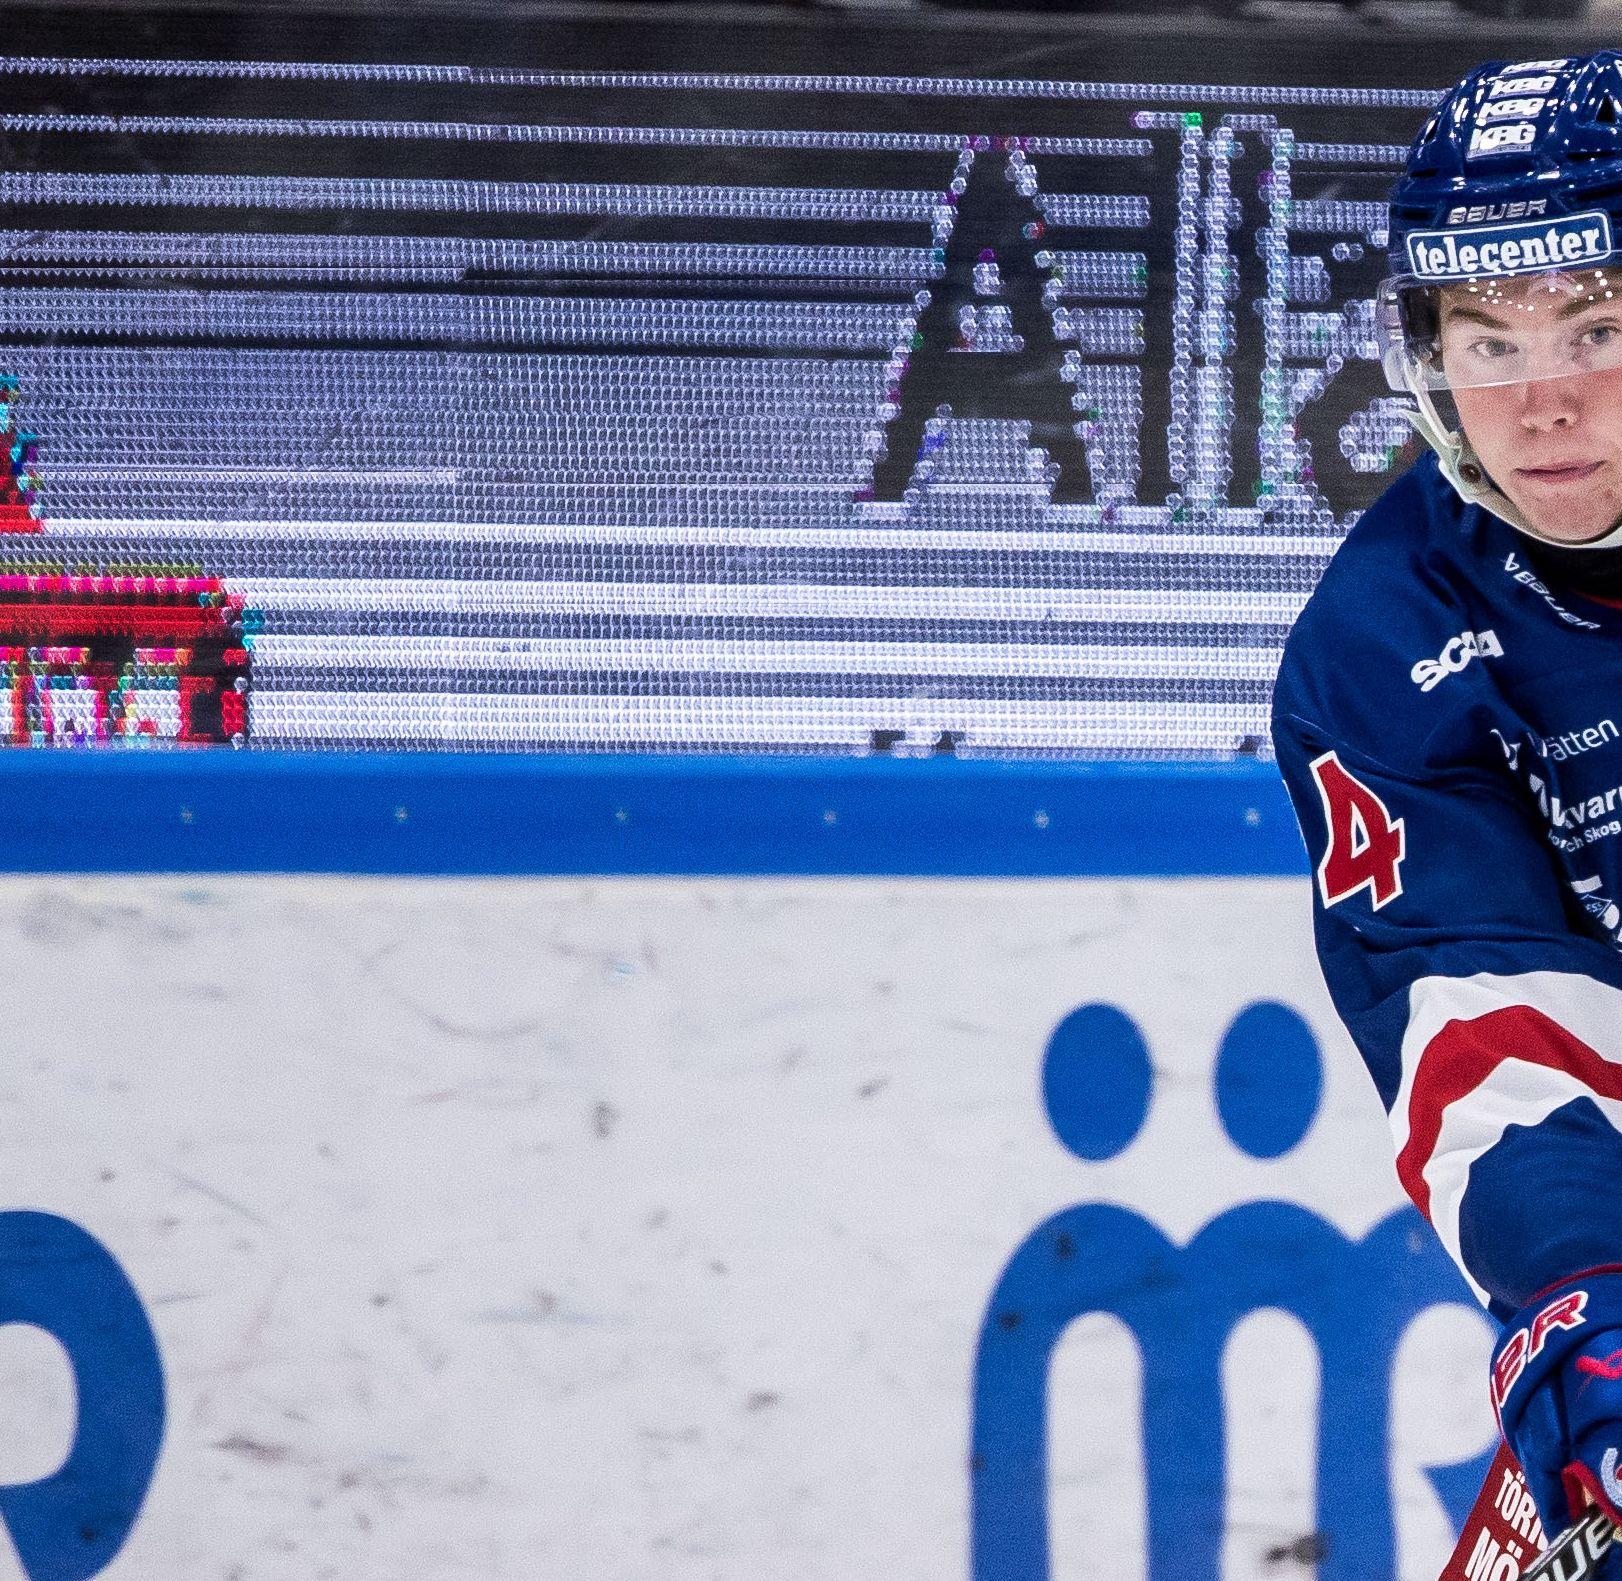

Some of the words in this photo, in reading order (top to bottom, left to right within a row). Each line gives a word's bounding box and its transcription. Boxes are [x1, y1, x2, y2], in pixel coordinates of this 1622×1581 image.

[1479, 98, 1545, 121] KBG
[1468, 124, 1536, 152] KBG
[1448, 199, 1547, 225] BAUER
[1416, 228, 1600, 274] telecenter
[1308, 749, 1406, 913] 4
[1584, 820, 1622, 843] Skog
